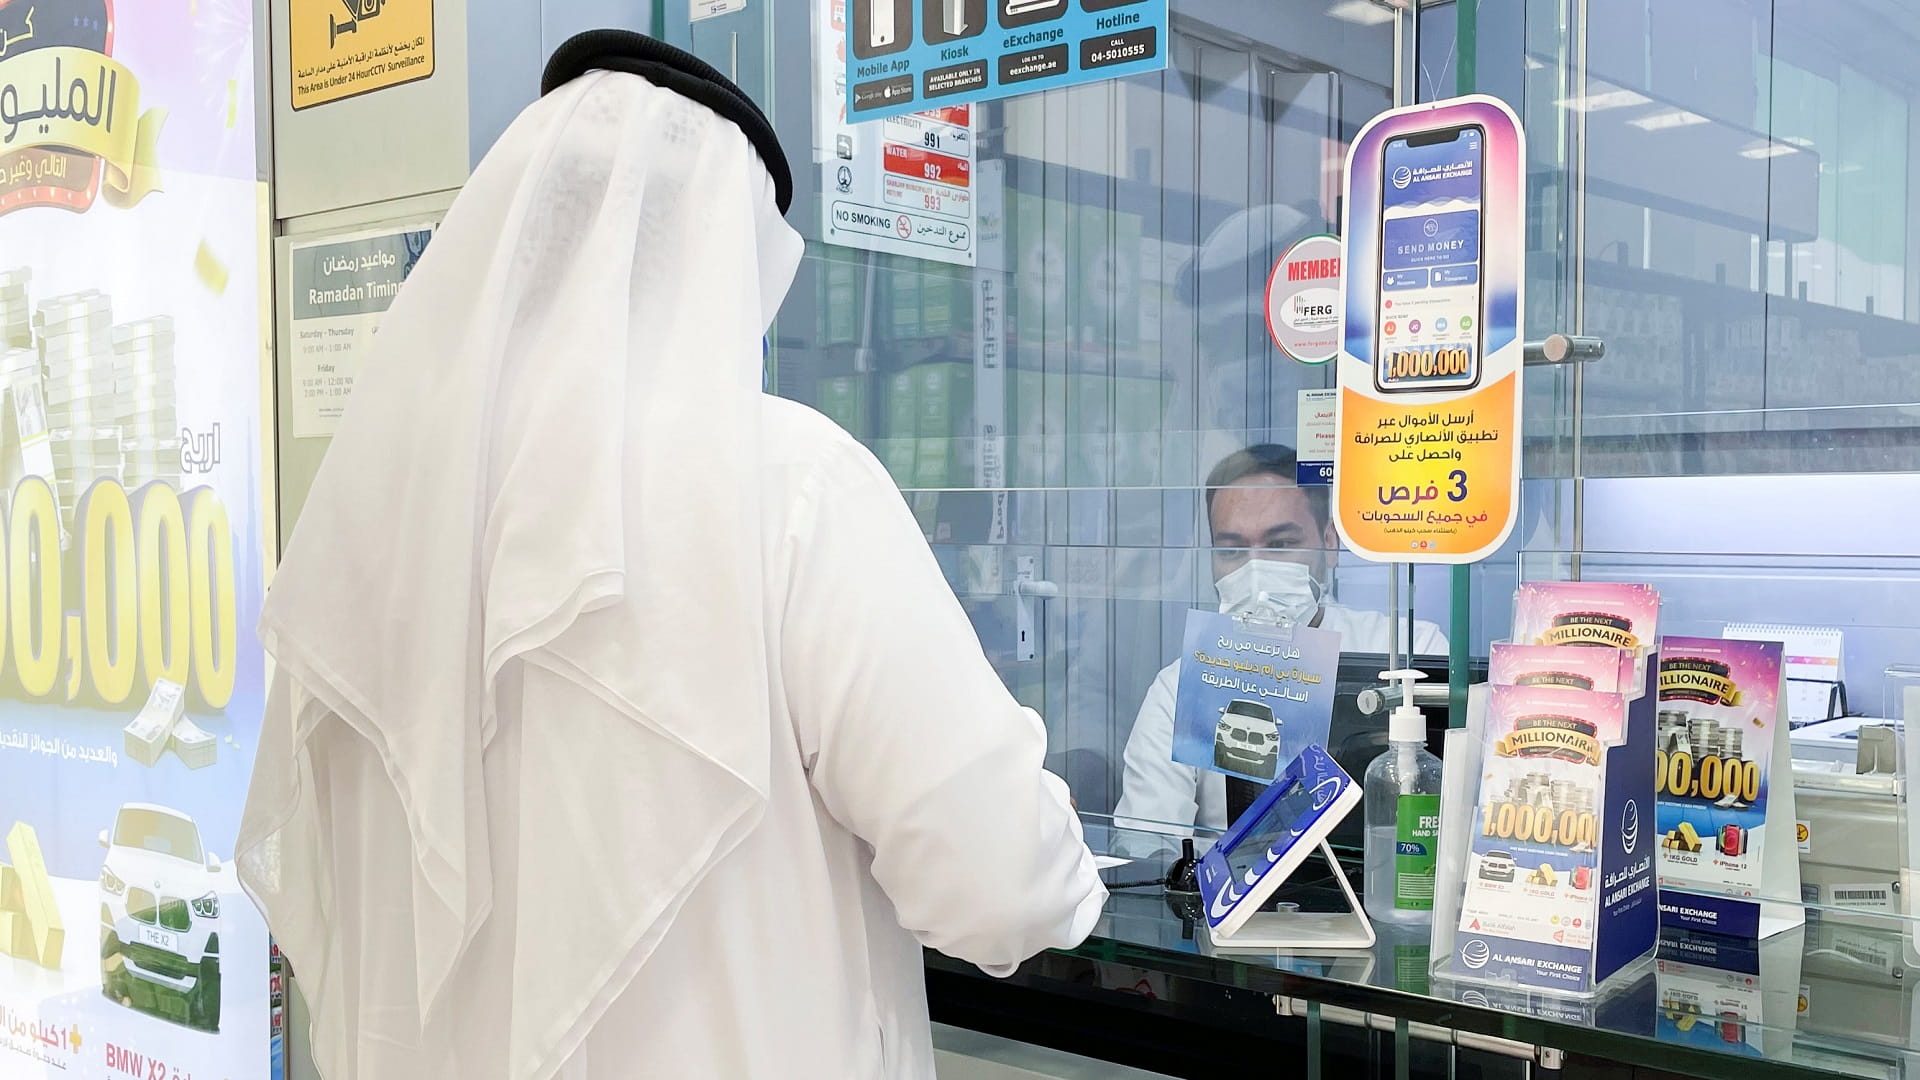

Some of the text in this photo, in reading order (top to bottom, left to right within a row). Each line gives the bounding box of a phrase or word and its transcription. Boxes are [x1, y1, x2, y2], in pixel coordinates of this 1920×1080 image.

[1096, 13, 1140, 30] Hotline
[1003, 27, 1064, 49] eExchange
[1110, 38, 1124, 46] CALL
[941, 45, 969, 61] Kiosk
[1091, 44, 1145, 63] 04-5010555
[298, 84, 309, 96] This
[310, 80, 323, 92] Area
[324, 79, 330, 88] is
[330, 74, 347, 87] Under
[348, 72, 356, 82] 24
[387, 54, 425, 72] Surveillance
[857, 59, 910, 78] Mobile App
[930, 67, 981, 83] AVAILABLE ONLY IN
[1009, 61, 1057, 76] eexchange.ae
[929, 75, 982, 92] SELECTED BRANCHES
[1, 57, 116, 143] المليو
[924, 131, 940, 148] 991
[886, 146, 908, 159] WATER
[924, 163, 941, 180] 992
[1421, 173, 1441, 182] ANSARI
[1442, 169, 1473, 178] EXCHANGE
[924, 194, 941, 210] 993
[836, 210, 891, 229] NO SMOKING
[917, 226, 947, 237] التدخين
[1397, 239, 1464, 255] SEND MONEY
[323, 249, 396, 276] مواعيد رمضان
[1288, 257, 1340, 281] MEMBE
[309, 286, 364, 305] Ramadan
[1303, 304, 1333, 317] FERG
[328, 328, 354, 337] Thursday
[317, 364, 335, 373] Friday
[1386, 348, 1469, 378] 1,000,000
[1377, 410, 1474, 430] أرسل الأموال عبر
[1354, 429, 1498, 448] تطبيق الأنصاري للصرافة
[1388, 448, 1462, 463] واحصل على
[1378, 469, 1468, 505] 3 فرص
[1426, 510, 1463, 525] جميع
[1465, 510, 1488, 528] في
[0, 474, 237, 709] 0,000
[1580, 616, 1593, 624] THE
[1594, 618, 1613, 626] NEXT
[1550, 627, 1633, 648] MILLIONAIRE
[1217, 634, 1300, 659] هل ترغب في ربح
[1232, 657, 1260, 674] دبليو
[1692, 664, 1712, 672] NEXT
[1201, 671, 1240, 690] الطريقة
[1275, 668, 1290, 682] بي
[1291, 667, 1322, 685] سيارة
[1241, 678, 1257, 694] عن
[1660, 674, 1729, 694] ILLIONAIRE
[1533, 719, 1577, 730] BE THE NEXT
[0, 728, 28, 750] النقدي
[61, 739, 77, 760] من
[79, 745, 118, 768] والعديد
[1419, 815, 1439, 829] FRE
[1412, 829, 1431, 837] HAND
[1400, 843, 1420, 853] 70%
[1719, 860, 1739, 868] iPhone
[1604, 894, 1611, 908] AL
[1611, 887, 1627, 904] ANSARI
[1628, 876, 1650, 896] EXCHANGE
[1658, 904, 1717, 919] NSARI EXCHANGE
[146, 930, 169, 947] THE X2
[1492, 953, 1583, 974] AL ANSARI EXCHANGE
[1549, 971, 1561, 979] First
[106, 1042, 143, 1079] BMW
[148, 1057, 167, 1080] X2
